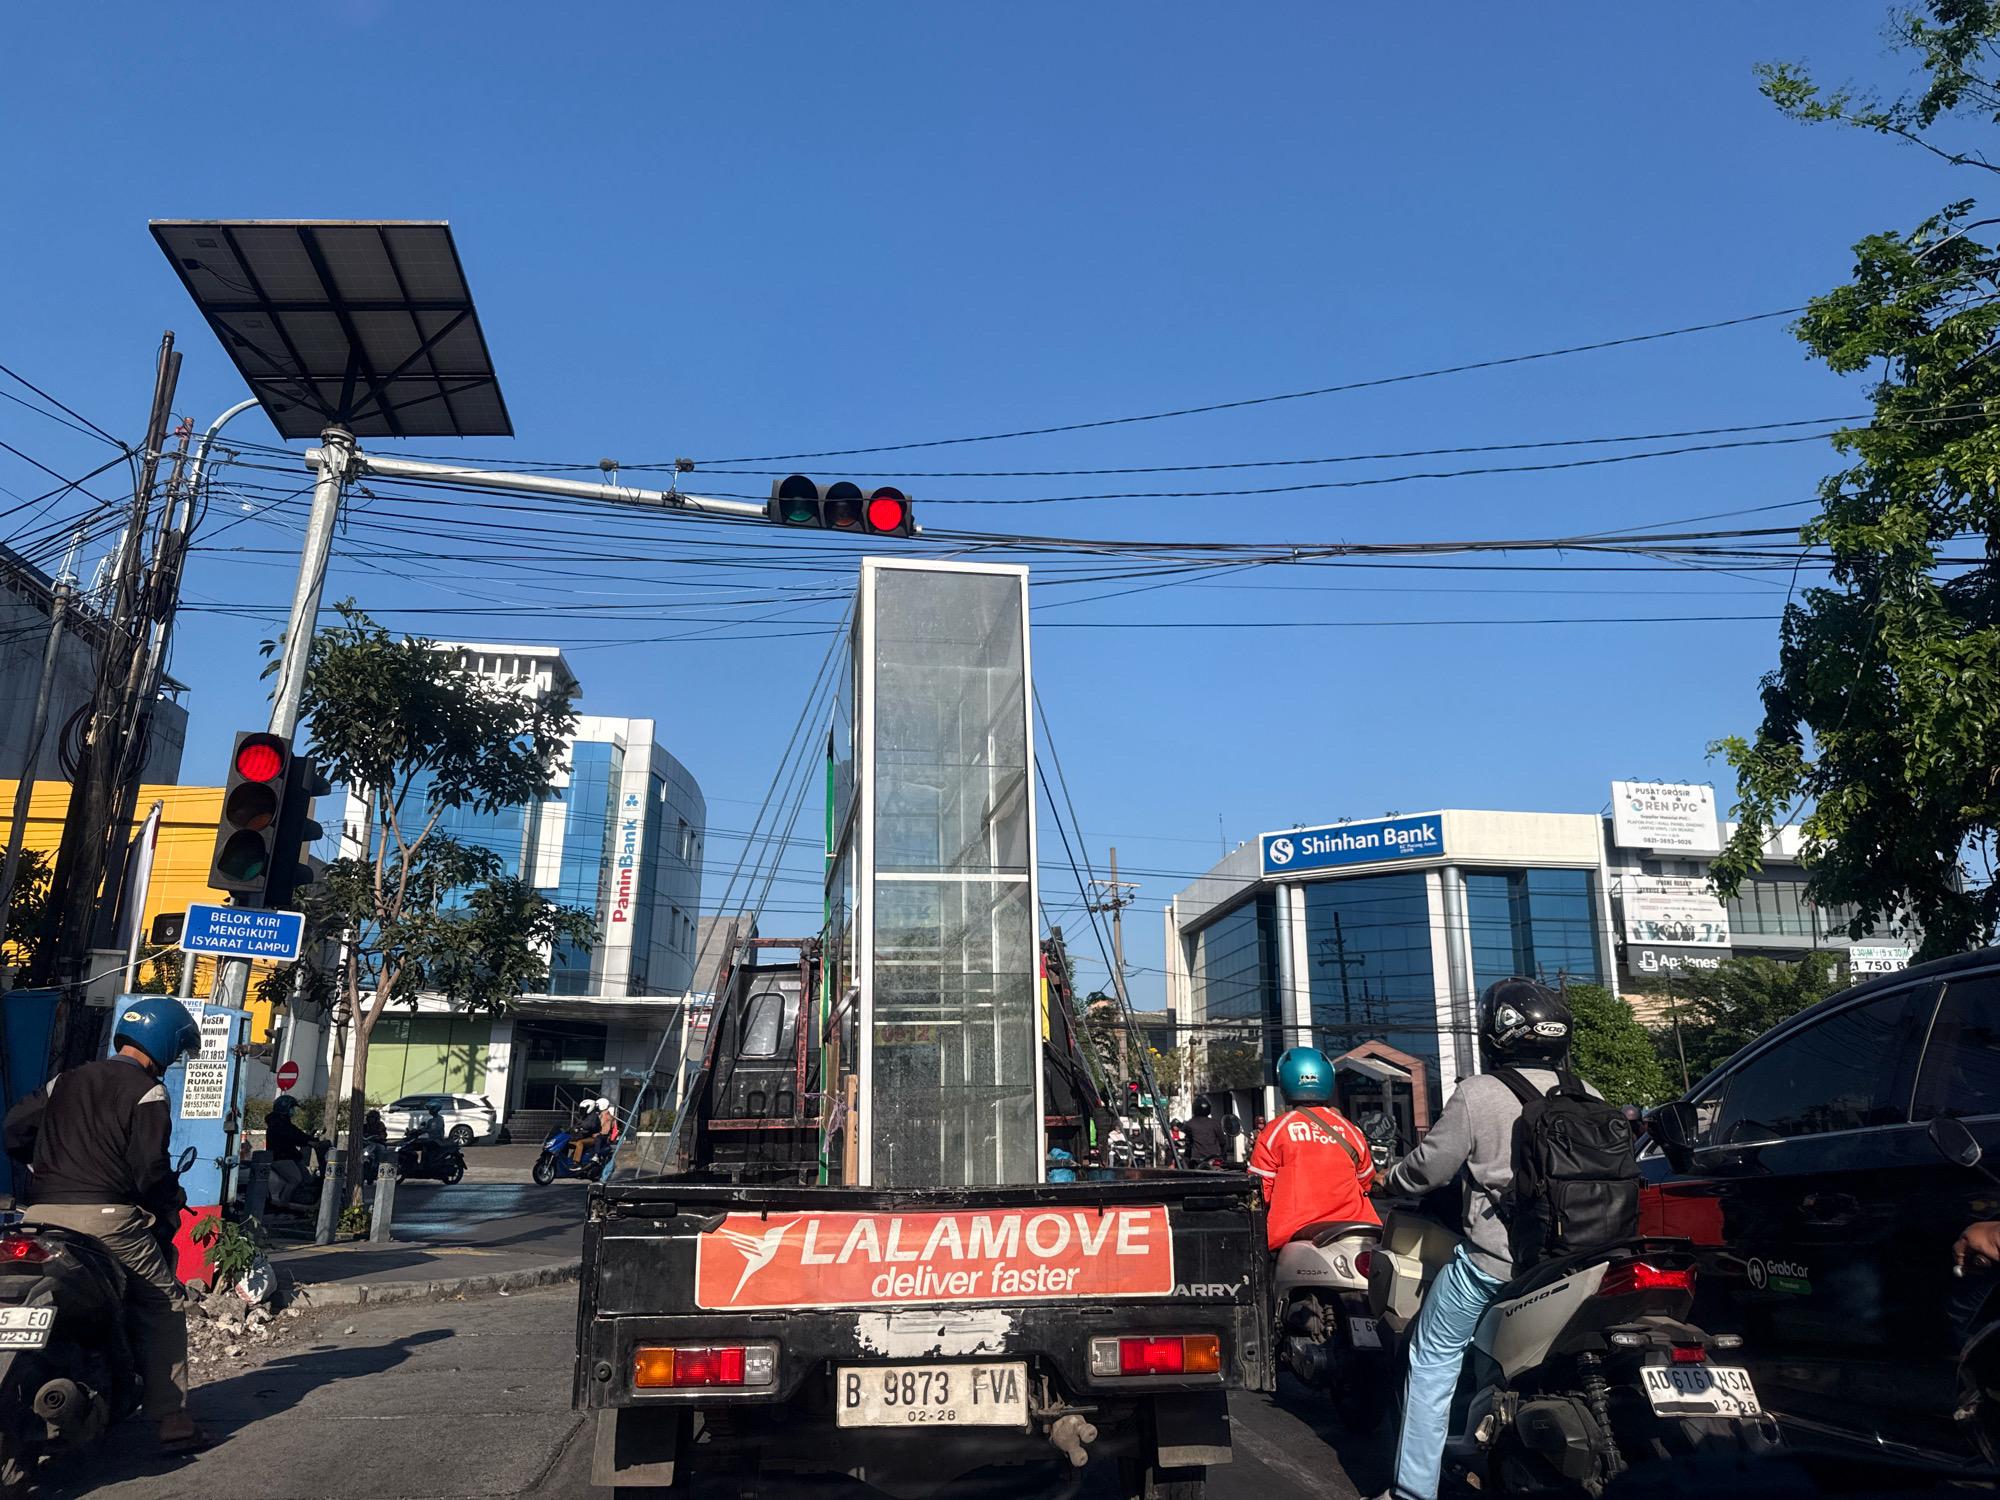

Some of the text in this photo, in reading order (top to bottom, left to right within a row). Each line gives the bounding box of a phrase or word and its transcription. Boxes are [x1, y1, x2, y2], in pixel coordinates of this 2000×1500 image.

[1645, 801, 1698, 812] REN PVC
[1301, 823, 1436, 855] Shinhan Bank
[612, 818, 637, 922] PaninBank
[210, 912, 280, 927] BELOK KIRI
[209, 924, 278, 940] MENGIKUTI
[192, 936, 290, 953] ISYARAT LAMPU
[1865, 961, 1892, 970] 750
[204, 1039, 216, 1047] 081
[800, 1210, 1152, 1265] LALAMOVE
[1766, 1260, 1808, 1278] GrabCar
[871, 1262, 1080, 1298] deliver faster
[1172, 1284, 1242, 1296] ARRY
[1505, 1291, 1550, 1318] VARIO
[1353, 1320, 1360, 1332] L
[846, 1369, 1019, 1408] B 9873 FVA
[1646, 1370, 1752, 1392] AD 6161 NSA
